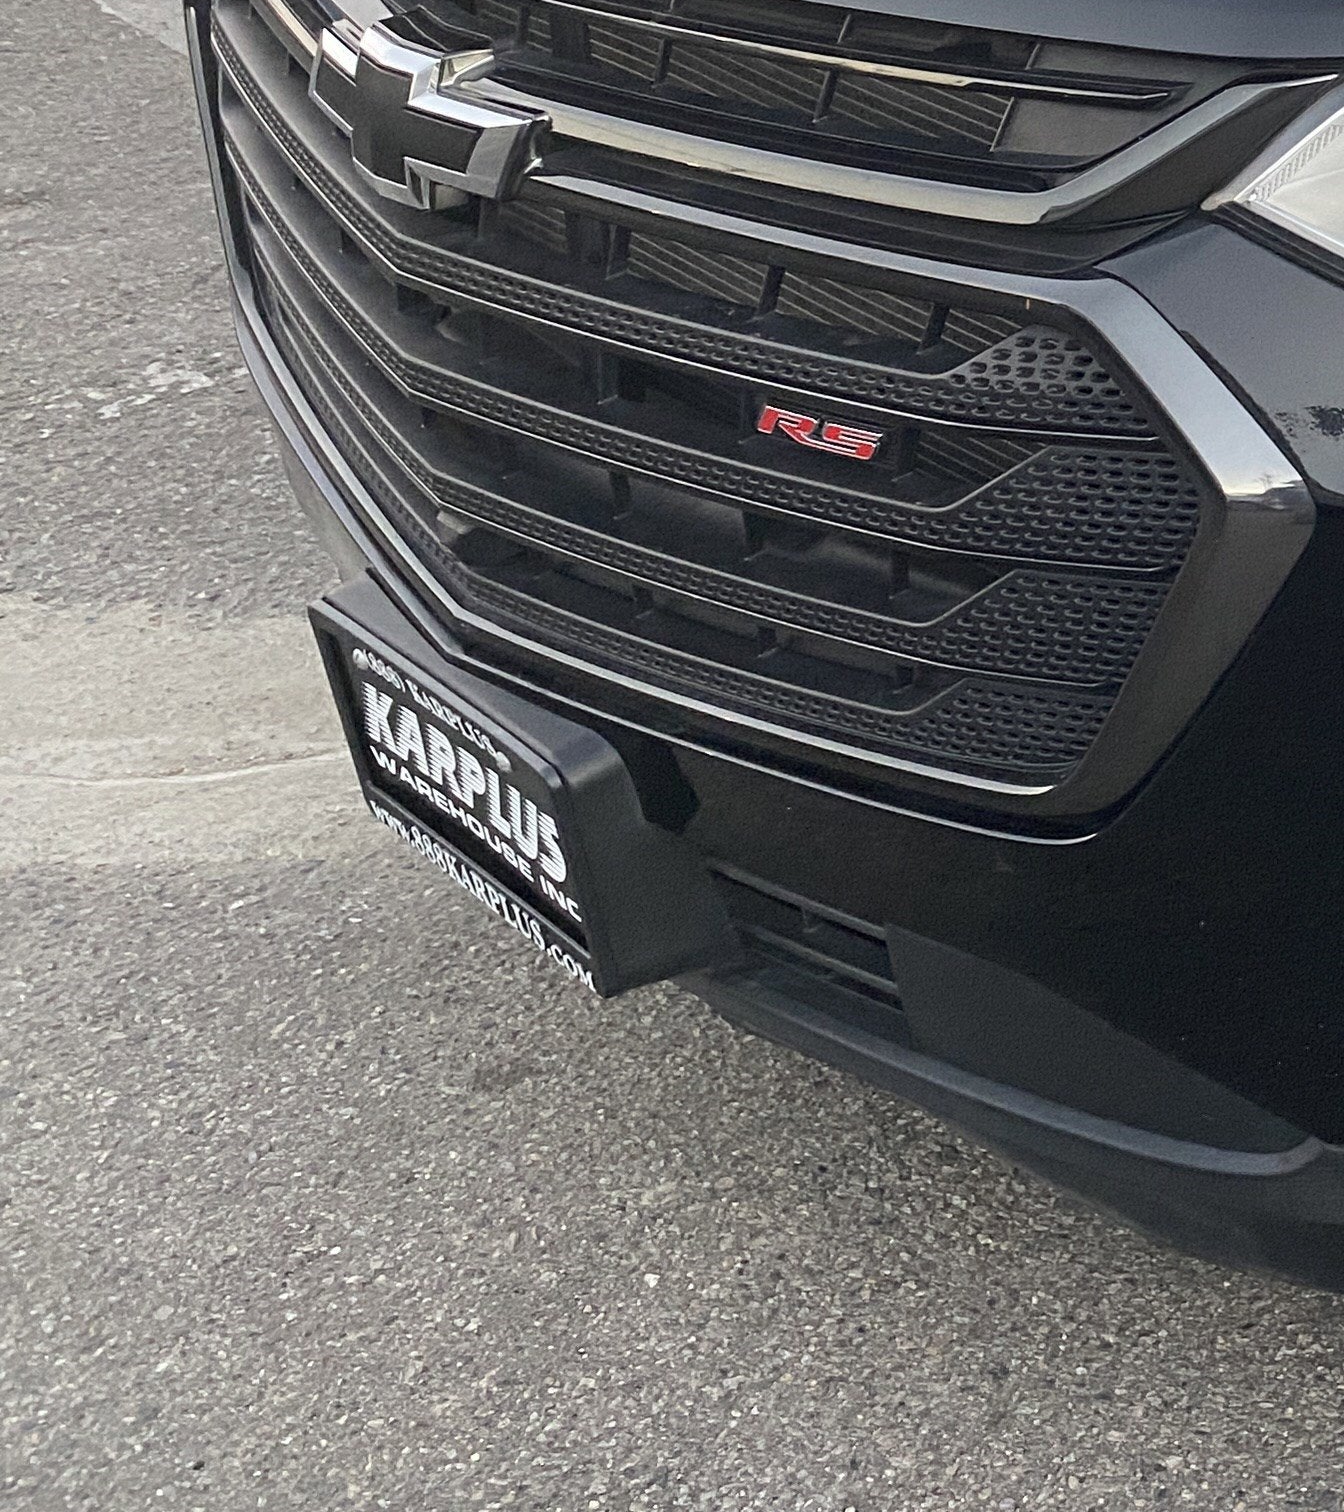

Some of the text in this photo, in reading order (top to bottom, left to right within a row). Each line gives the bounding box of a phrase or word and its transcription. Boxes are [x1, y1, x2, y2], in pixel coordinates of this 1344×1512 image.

[757, 405, 883, 461] RS
[361, 681, 567, 883] KARPLUS
[370, 744, 583, 923] WAREHOUSE INC
